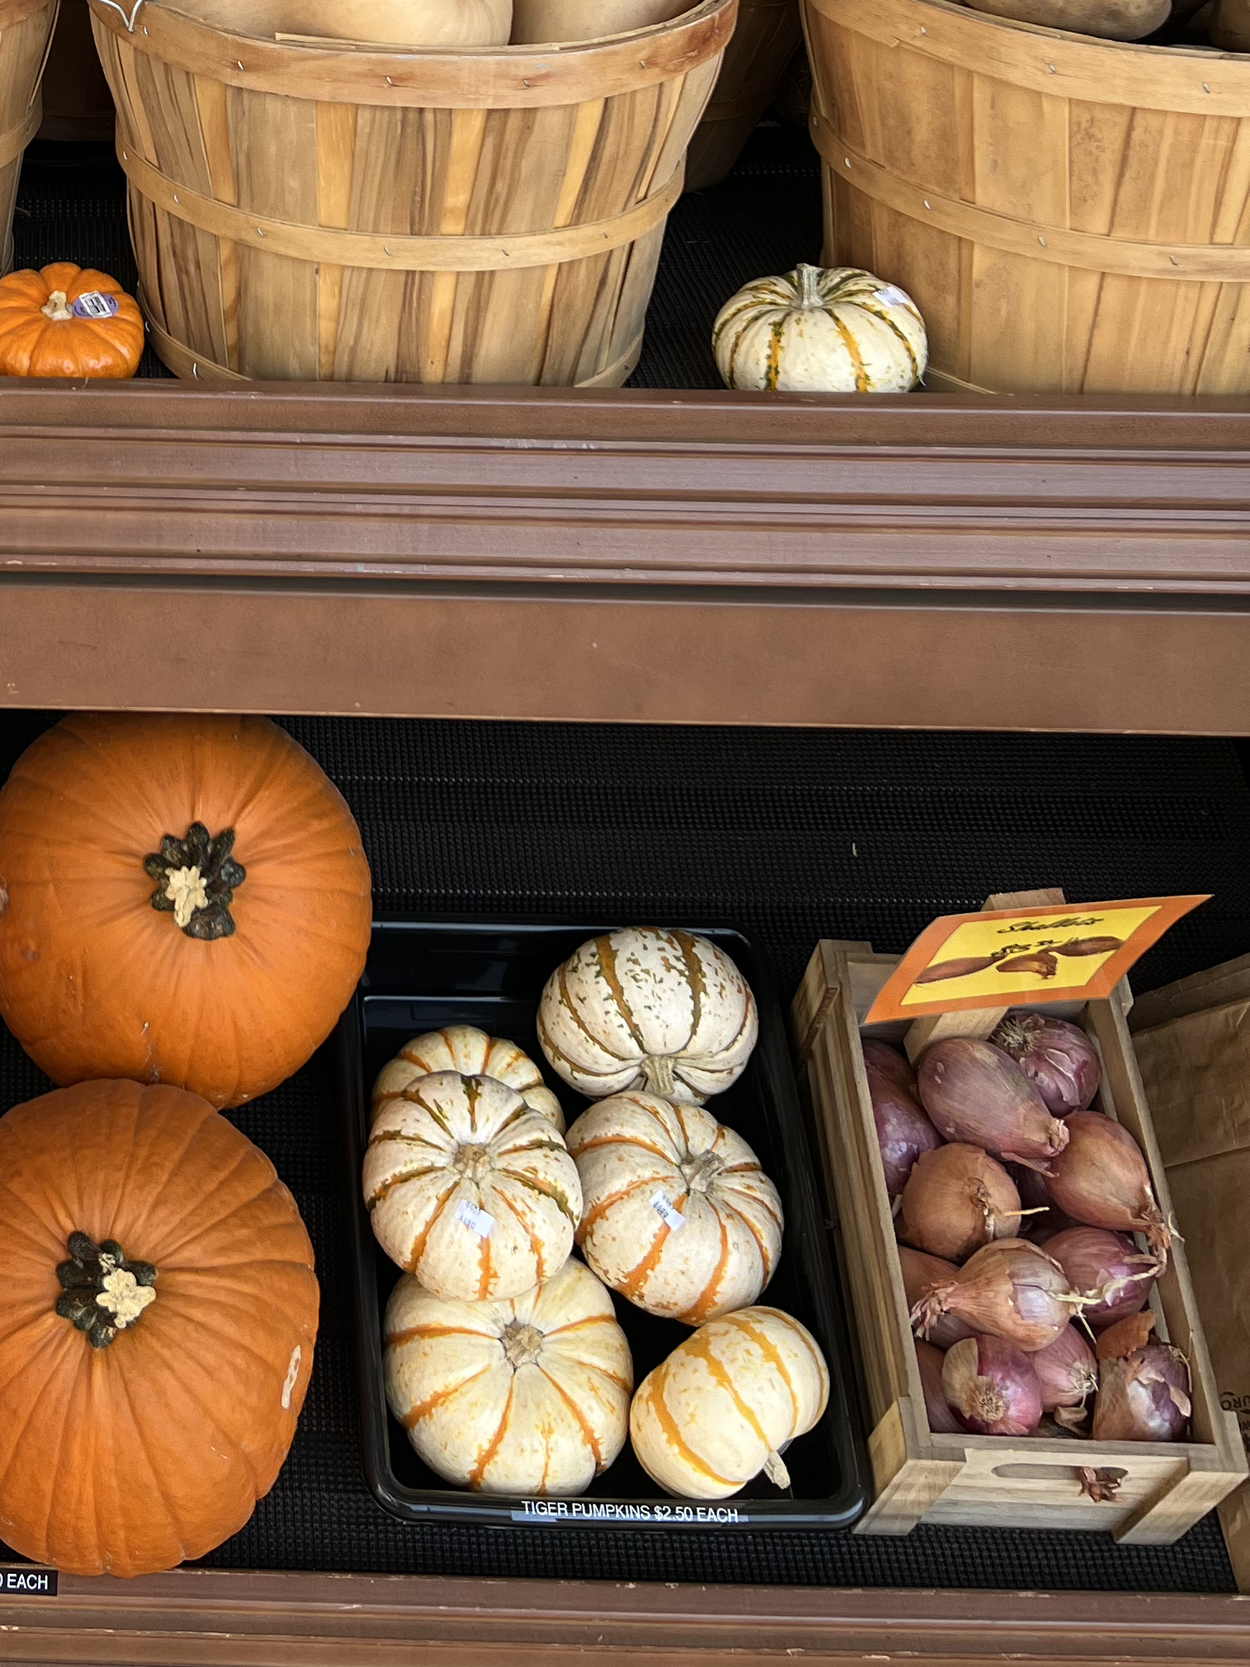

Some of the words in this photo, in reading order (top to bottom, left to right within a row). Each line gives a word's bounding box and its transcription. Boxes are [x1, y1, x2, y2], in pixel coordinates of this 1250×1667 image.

[521, 1500, 569, 1516] TIGER
[572, 1502, 651, 1521] PUMPKINS
[653, 1505, 693, 1522] $2.50
[696, 1507, 739, 1523] EACH
[6, 1573, 49, 1590] EACH
